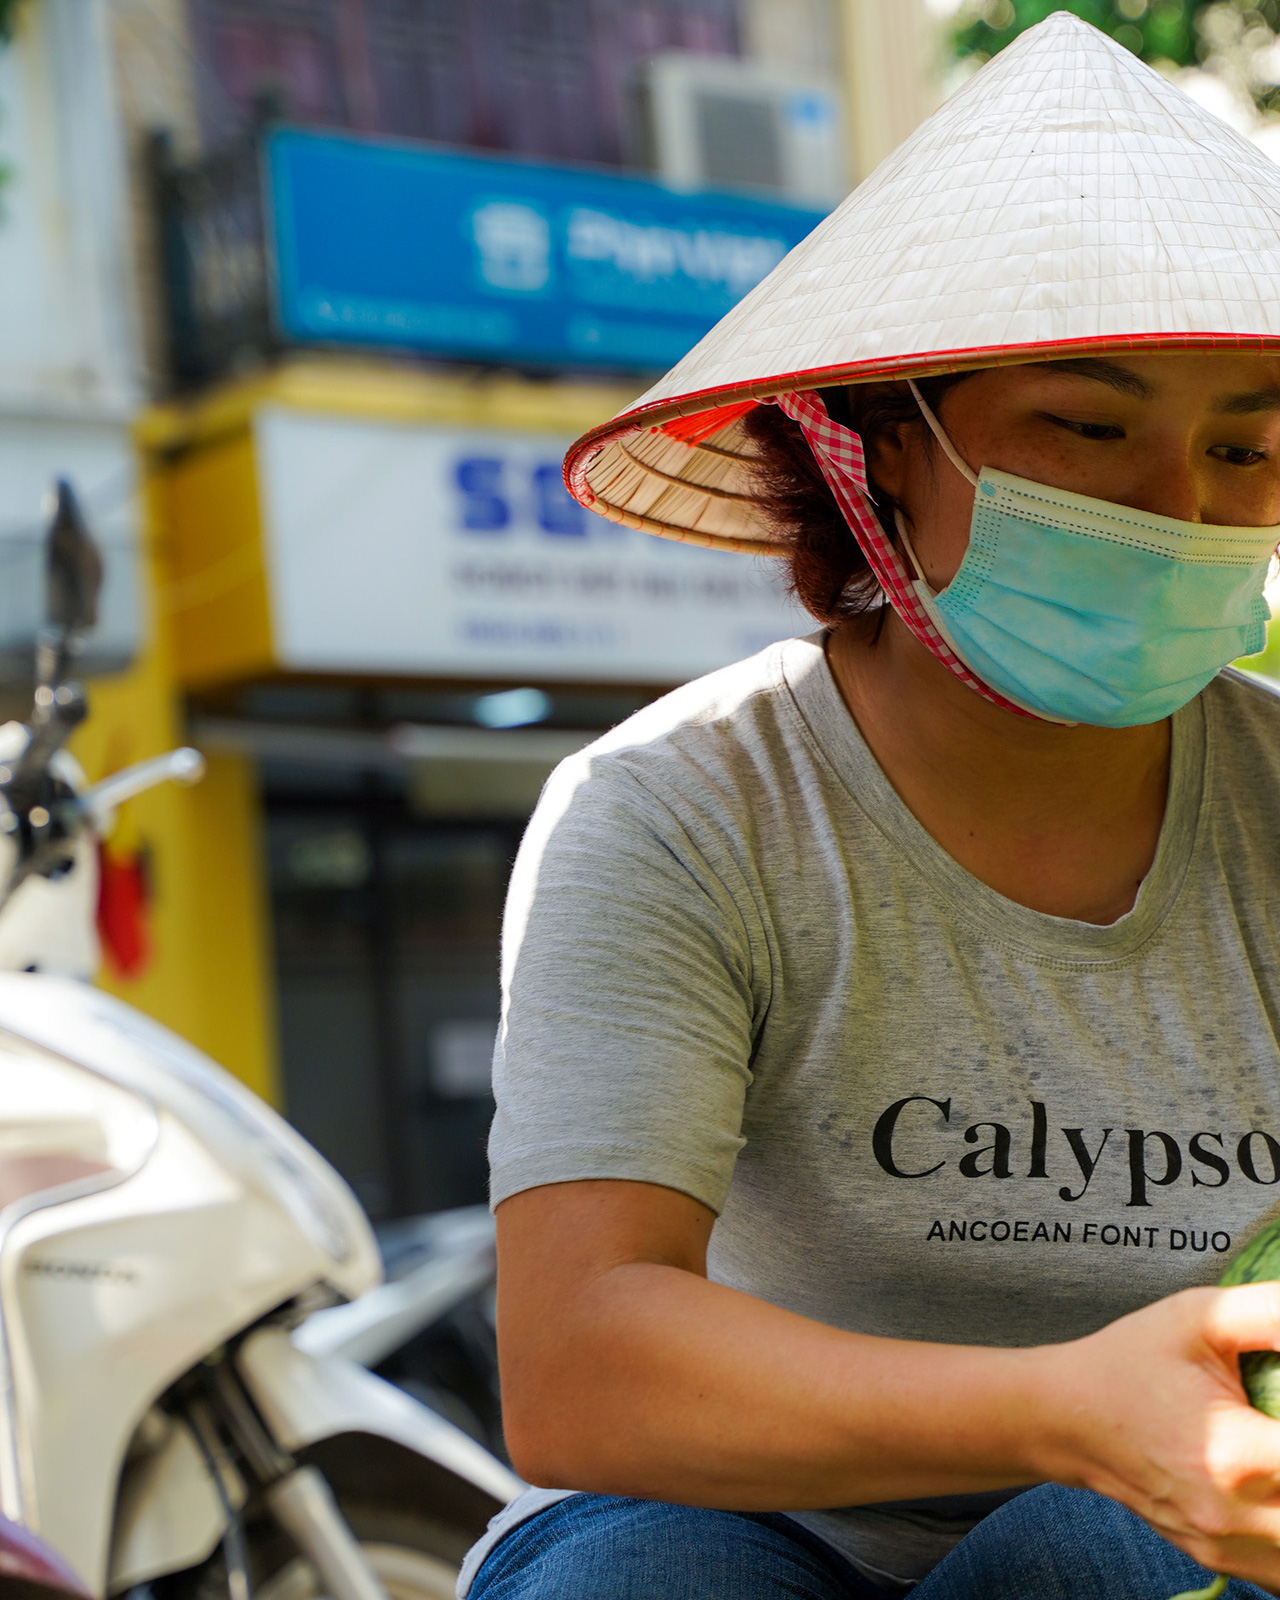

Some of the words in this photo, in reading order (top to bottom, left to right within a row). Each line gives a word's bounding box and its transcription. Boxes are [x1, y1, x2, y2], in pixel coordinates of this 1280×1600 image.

[926, 1221, 1071, 1242] ANCOEAN
[1083, 1224, 1159, 1248] FONT
[1171, 1230, 1230, 1252] DUO
